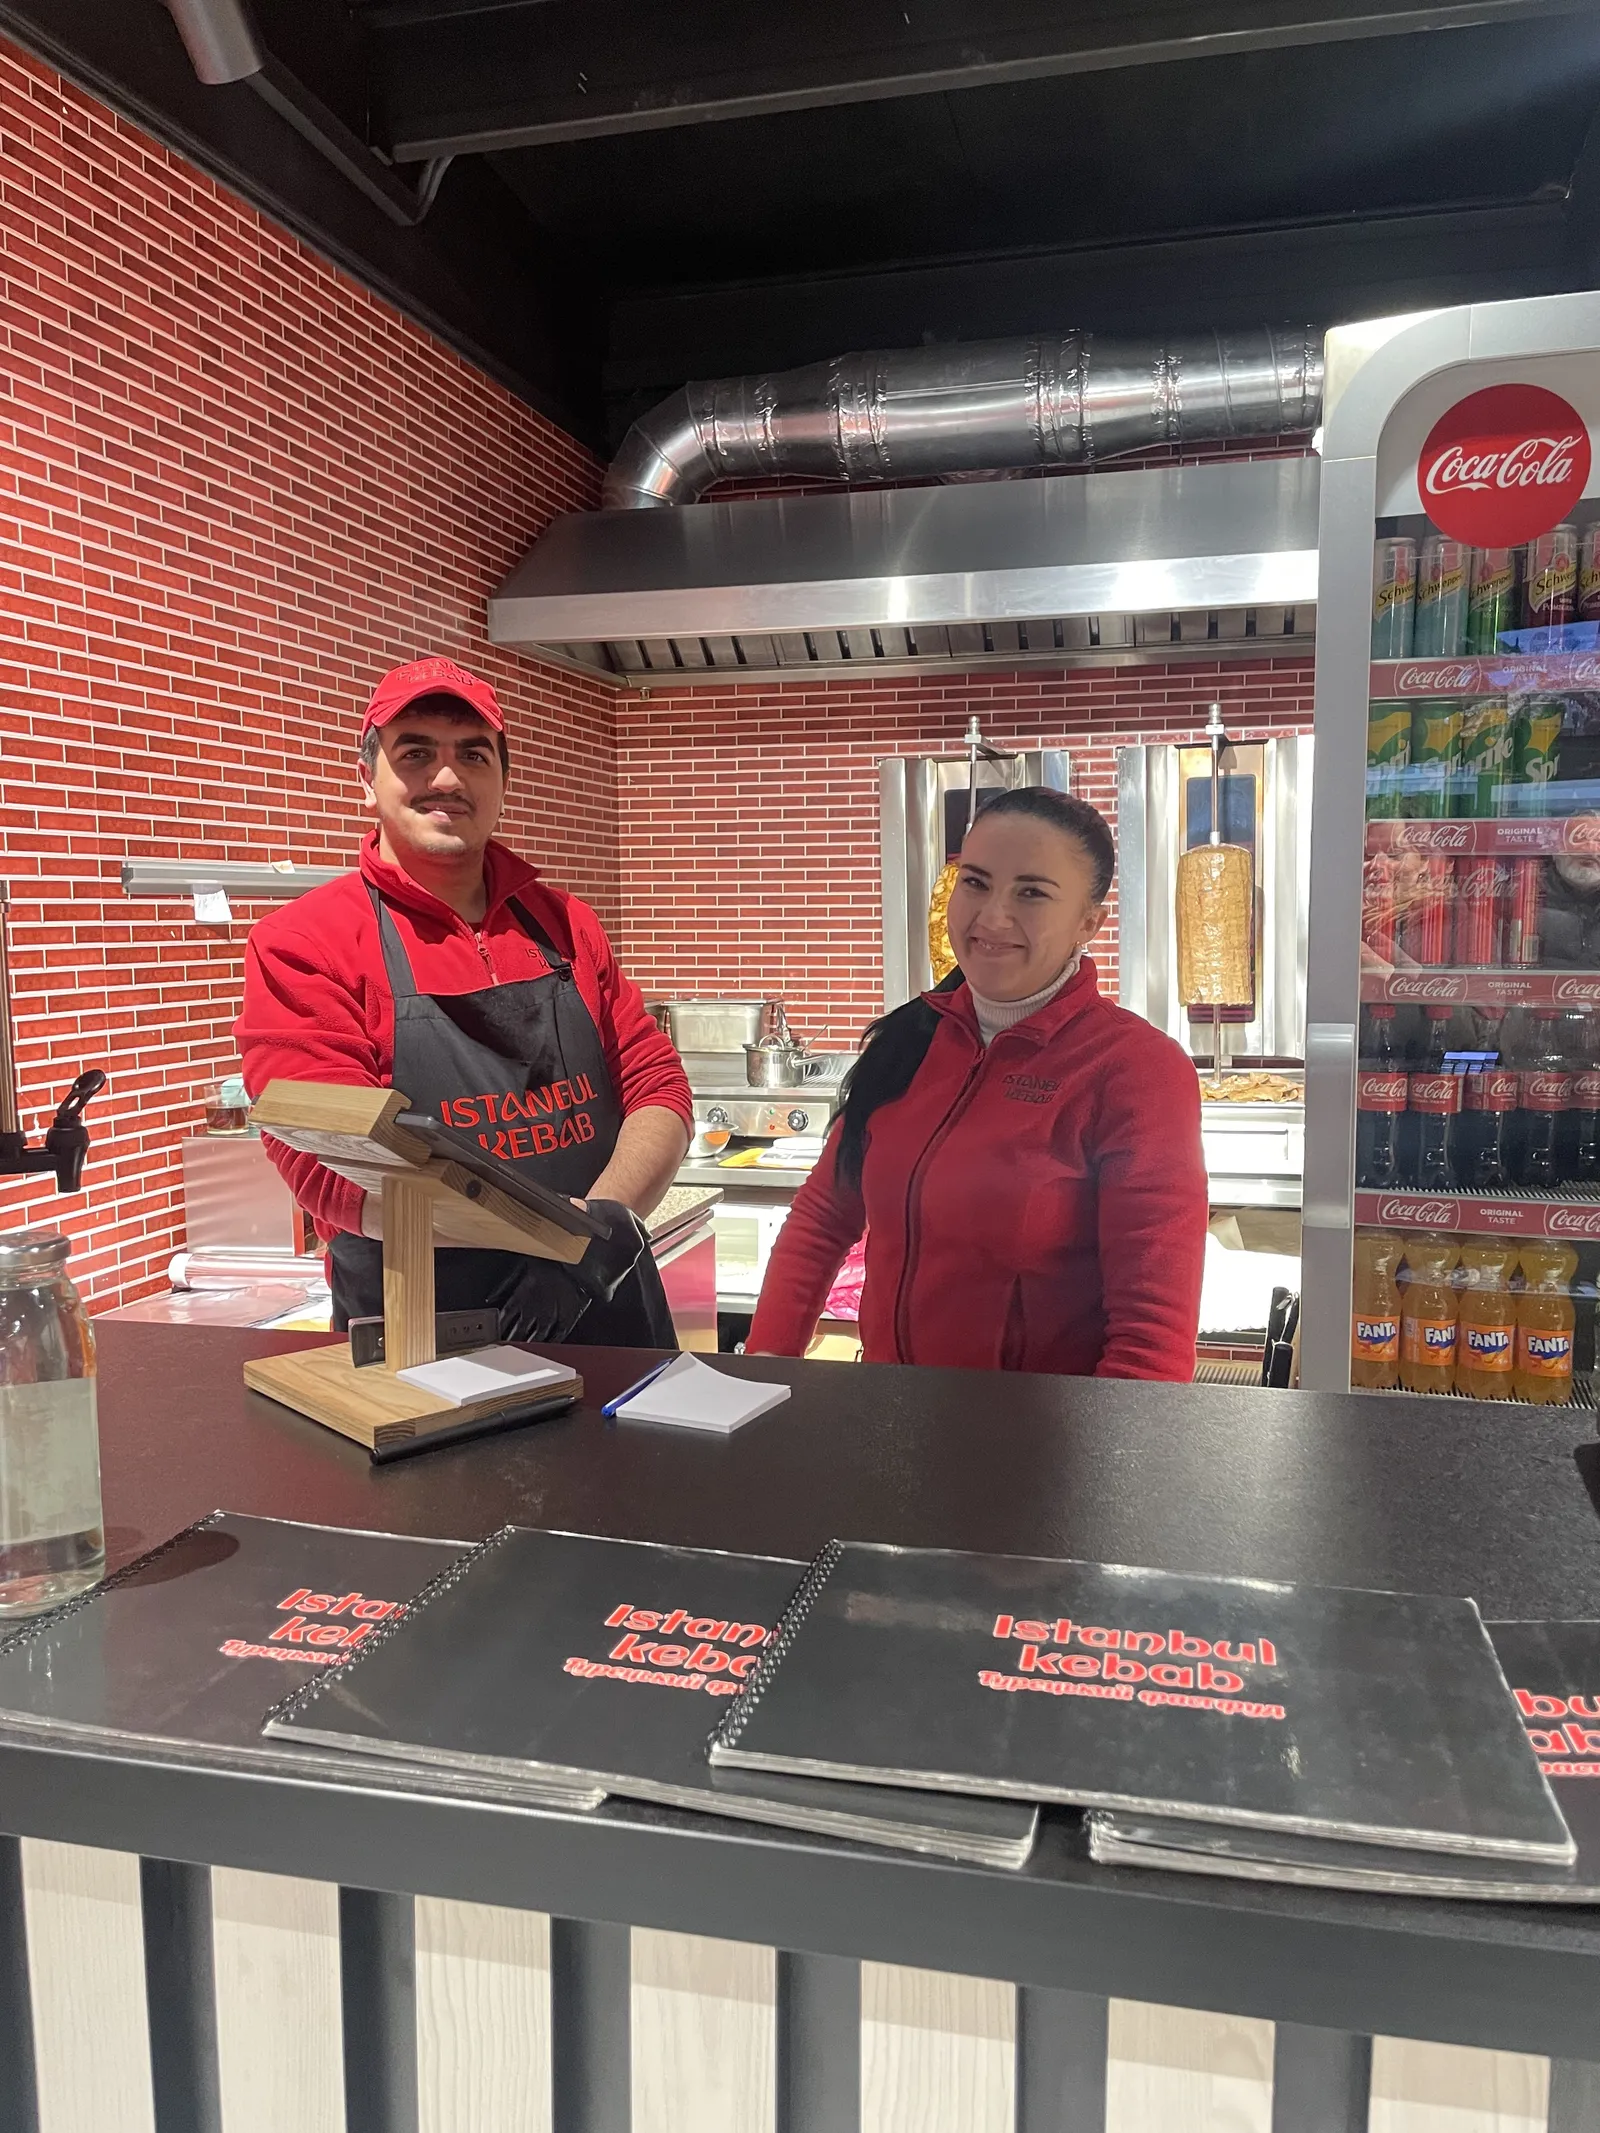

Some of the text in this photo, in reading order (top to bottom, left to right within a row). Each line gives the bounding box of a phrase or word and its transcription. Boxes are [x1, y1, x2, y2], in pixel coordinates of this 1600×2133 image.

[1426, 435, 1583, 495] Coca-Cola
[1400, 664, 1475, 690] Coca-Cola
[1396, 825, 1473, 848] Coca-Cola
[1497, 827, 1543, 836] ORIGINAL
[1389, 977, 1464, 998] Coca-Cola
[1488, 981, 1533, 990] ORIGINAL
[1496, 989, 1525, 997] TASTE
[477, 1111, 597, 1161] KEBAB
[1382, 1199, 1456, 1223] Coca-Cola
[1480, 1208, 1524, 1218] ORIGINAL
[1488, 1216, 1516, 1224] TASTE
[1356, 1321, 1397, 1338] FANTA
[1467, 1330, 1510, 1348] FANTA
[1527, 1336, 1570, 1353] FANTA
[992, 1614, 1279, 1666] Istanbul
[1018, 1643, 1245, 1693] kebab
